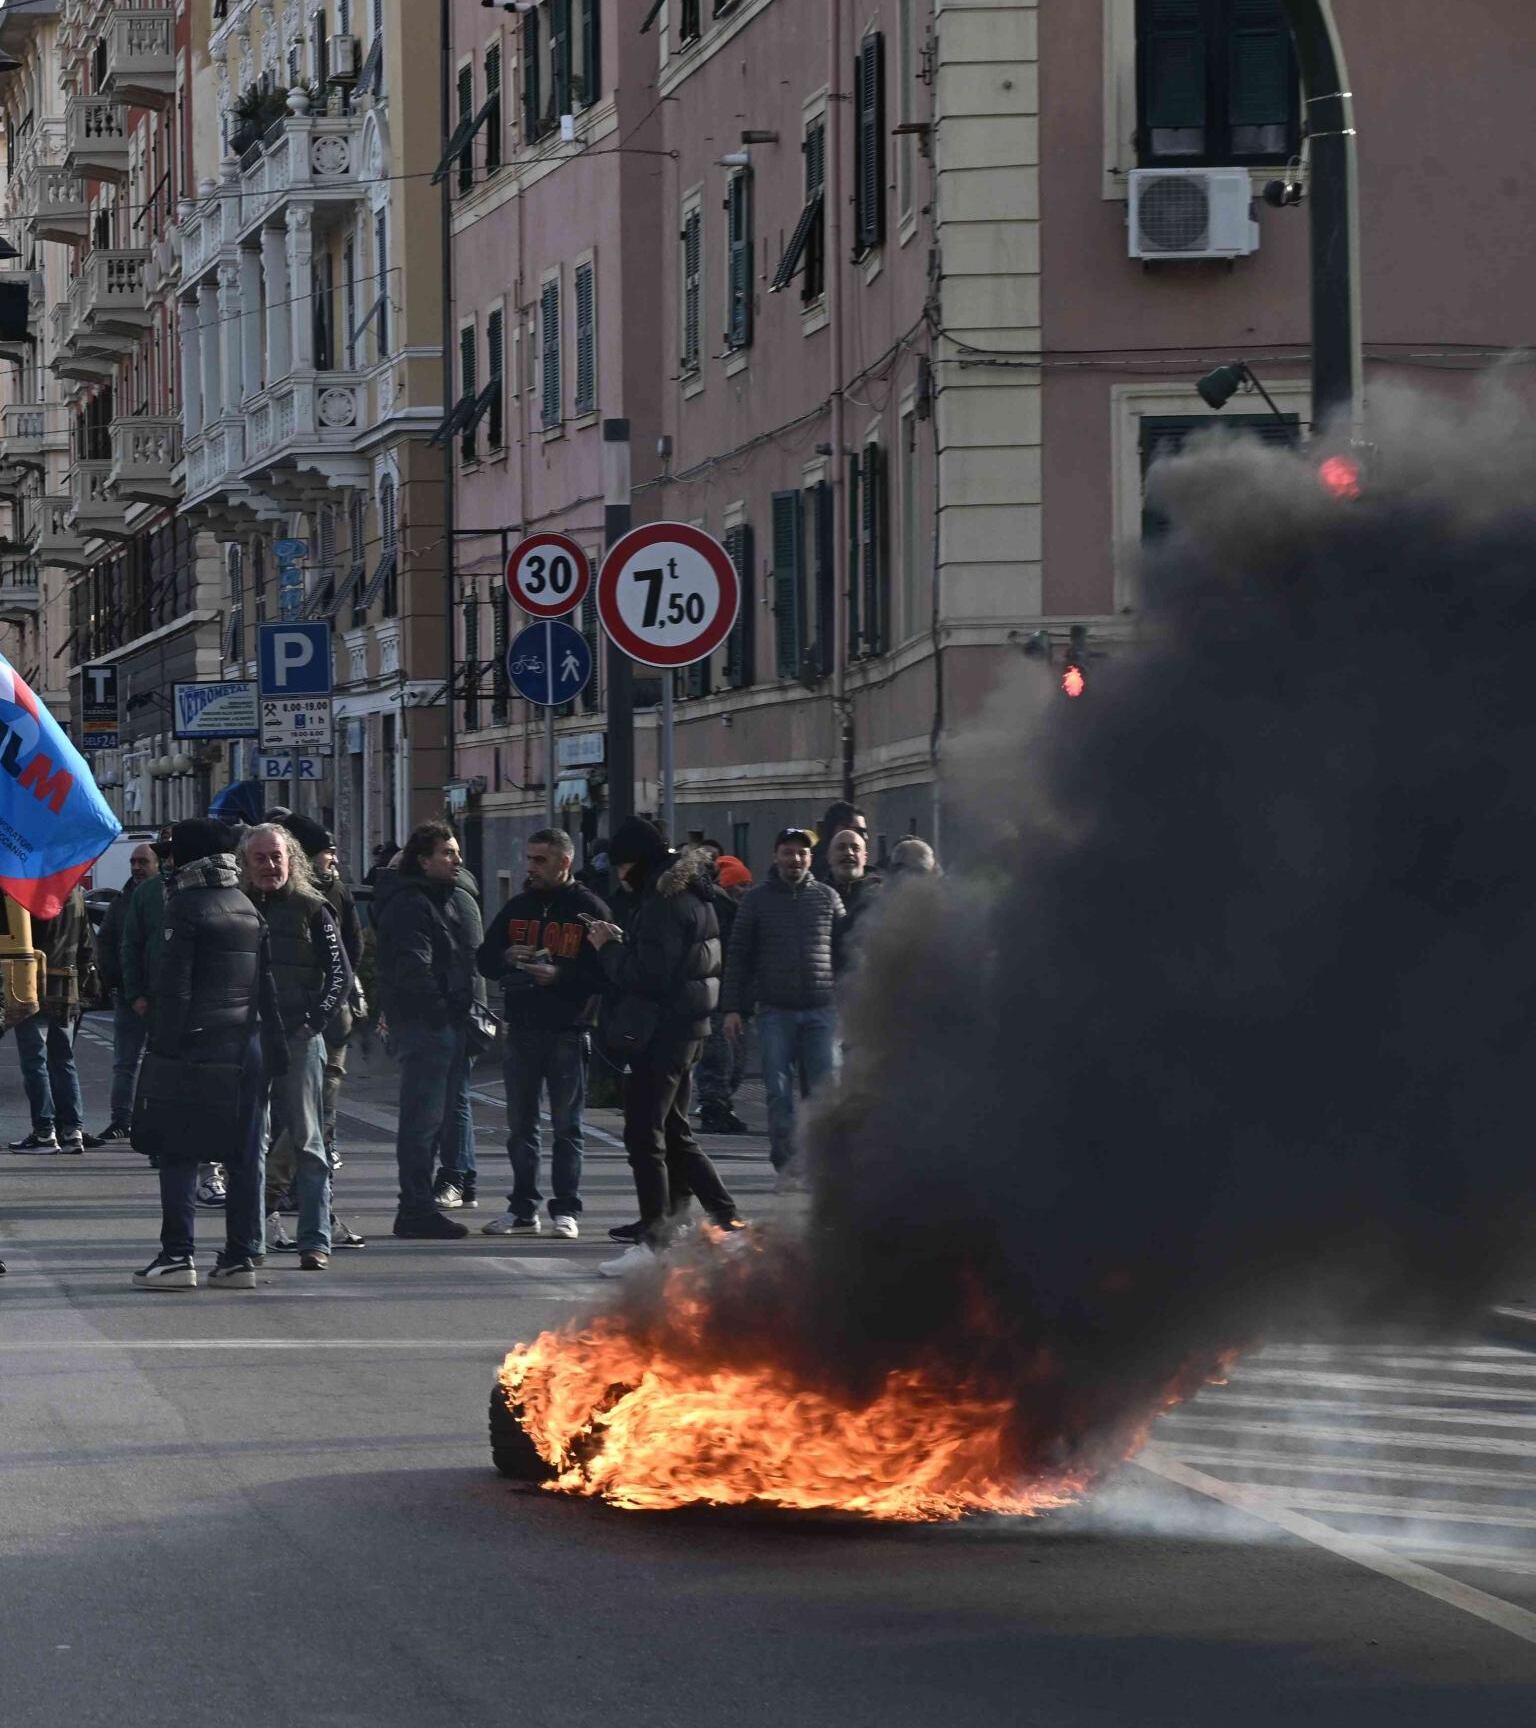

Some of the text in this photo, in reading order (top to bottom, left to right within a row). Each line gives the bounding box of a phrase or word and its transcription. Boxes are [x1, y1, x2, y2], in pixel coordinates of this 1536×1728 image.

[524, 555, 572, 594] 30
[667, 557, 679, 579] t
[274, 632, 314, 687] P
[88, 669, 111, 703] T
[179, 683, 249, 730] VETROMETAL
[266, 759, 315, 778] BAR
[319, 924, 344, 1011] SPINNAKER
